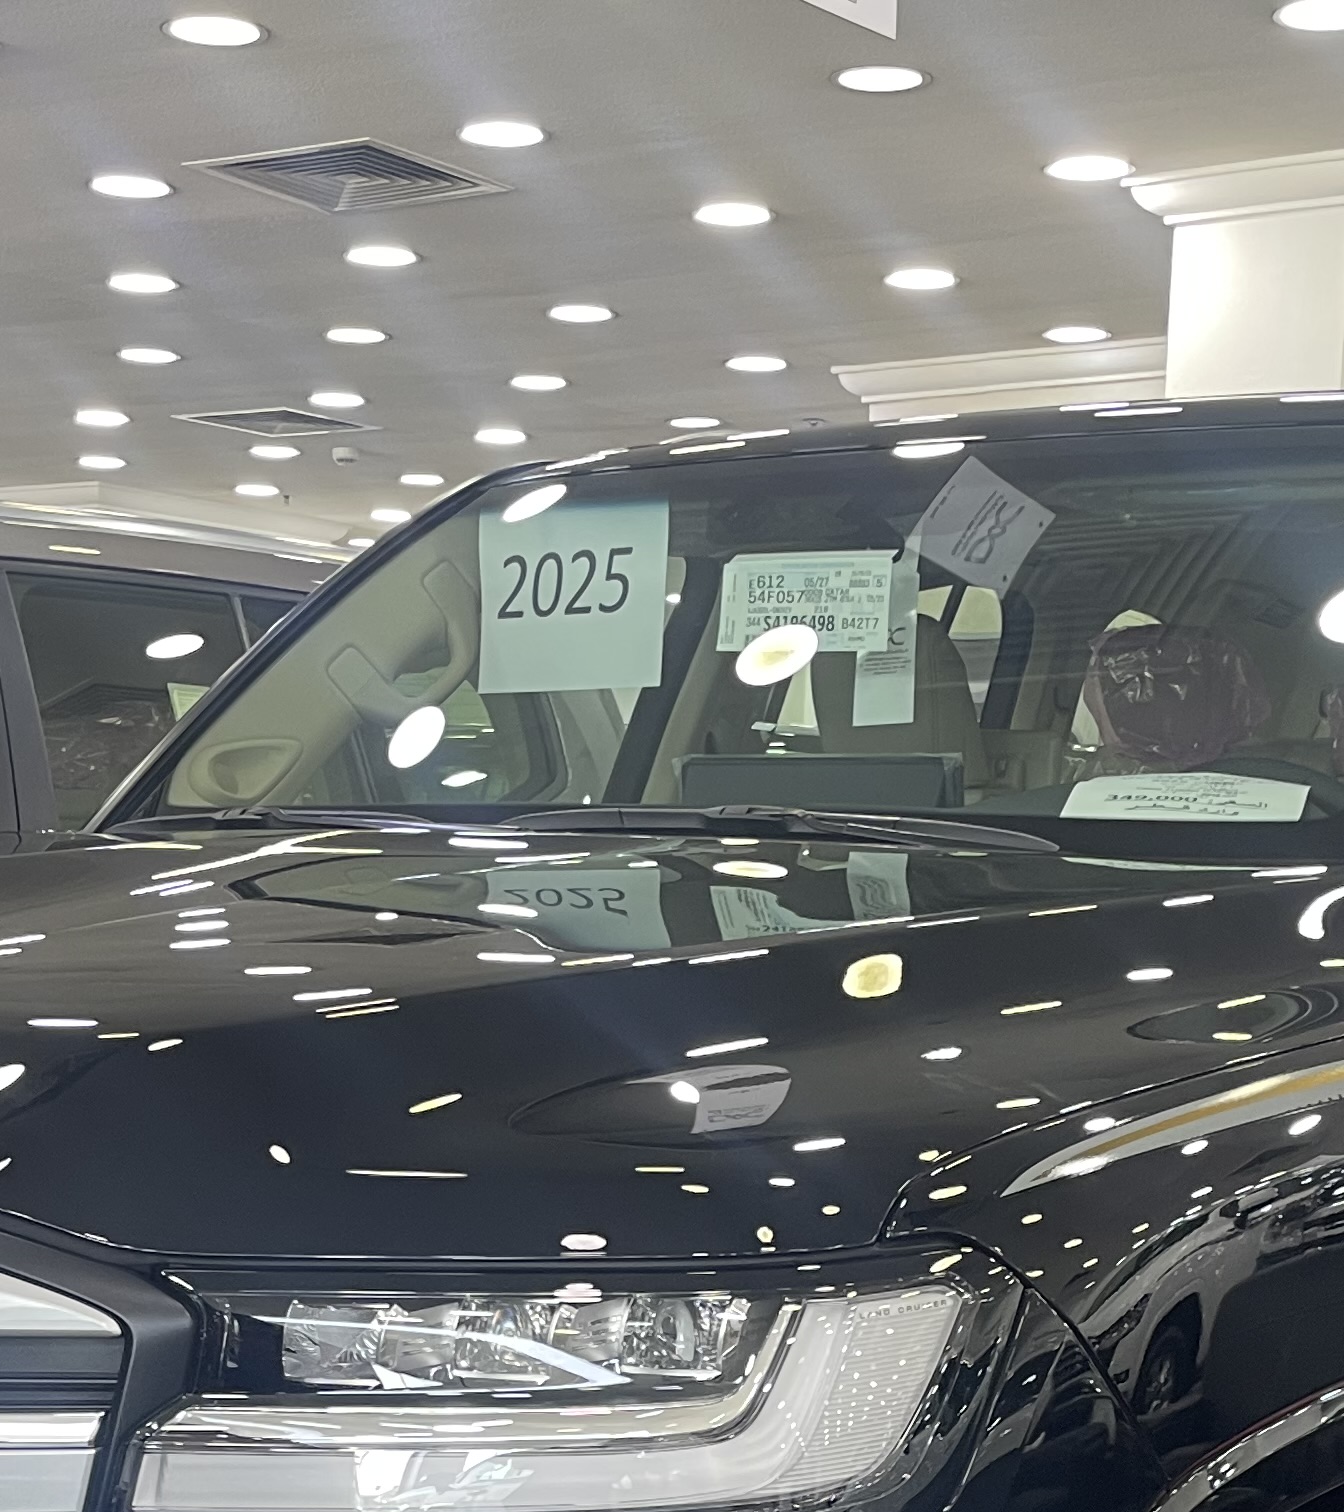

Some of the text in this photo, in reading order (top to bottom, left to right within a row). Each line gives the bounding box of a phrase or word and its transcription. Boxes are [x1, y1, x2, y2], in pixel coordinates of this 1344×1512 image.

[497, 547, 633, 619] 2025
[747, 590, 805, 604] 54F057
[841, 617, 879, 630] B42T7
[897, 1299, 947, 1314] CRUER
